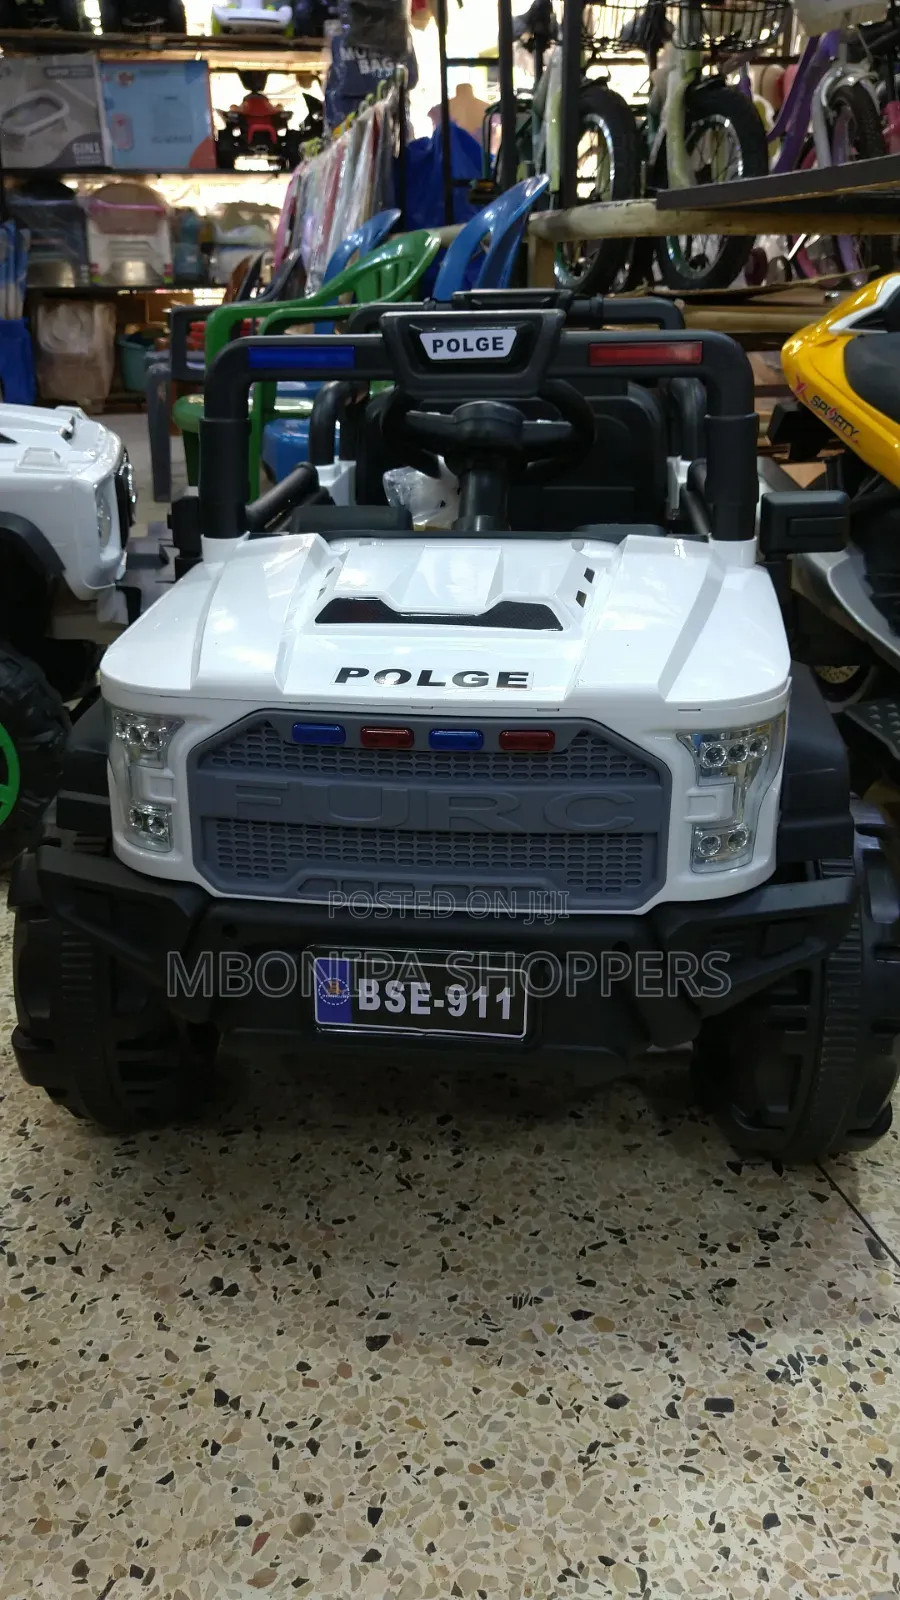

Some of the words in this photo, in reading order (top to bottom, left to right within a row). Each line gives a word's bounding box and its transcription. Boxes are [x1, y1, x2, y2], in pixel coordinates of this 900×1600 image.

[432, 336, 504, 353] POLGE
[811, 395, 859, 436] SPORTY
[335, 667, 529, 688] POLGE
[358, 978, 511, 1019] BSE-911
